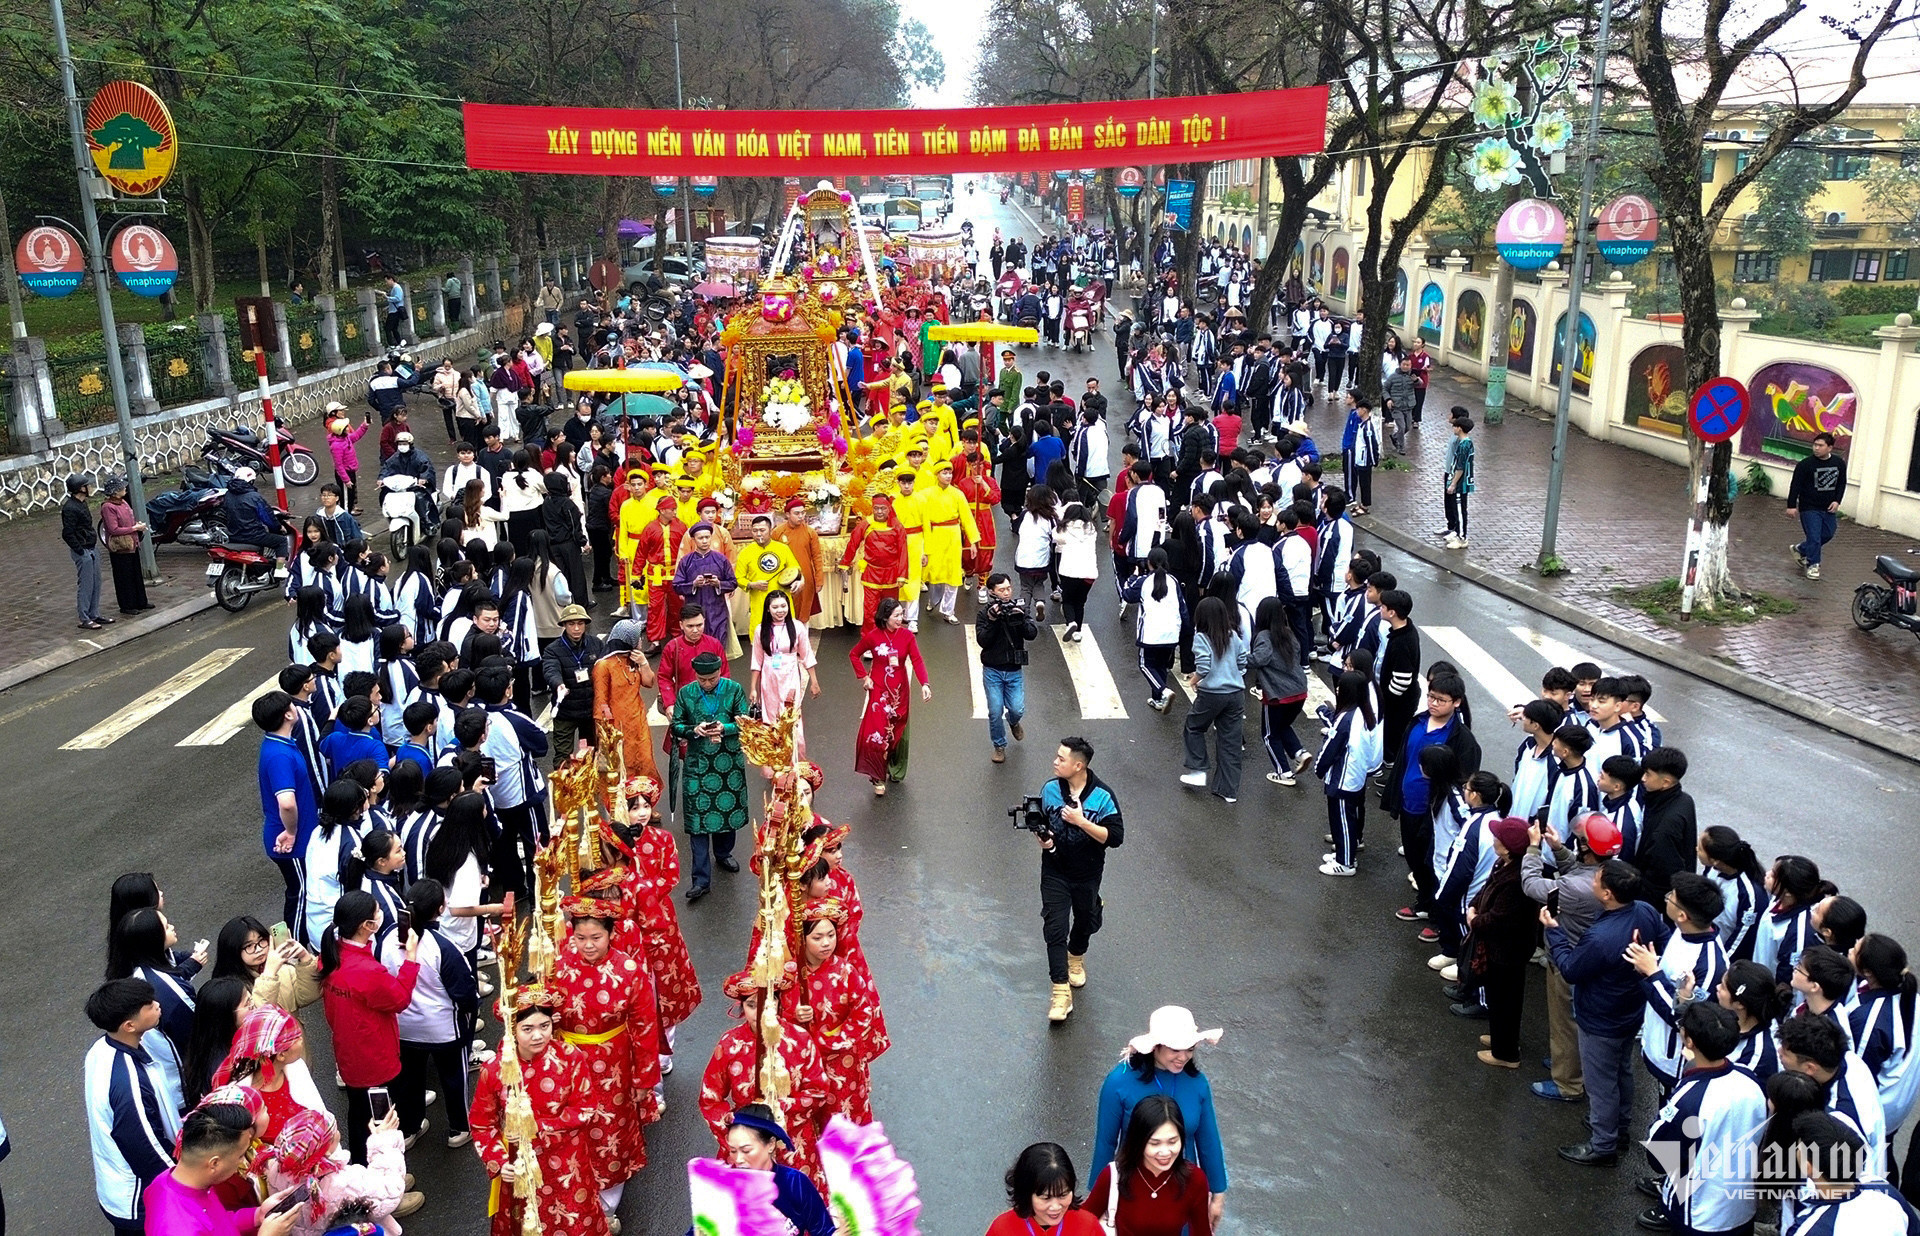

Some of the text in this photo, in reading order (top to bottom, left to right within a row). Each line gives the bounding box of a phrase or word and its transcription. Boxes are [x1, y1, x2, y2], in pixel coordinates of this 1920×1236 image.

[547, 126, 579, 155] XÂY
[591, 128, 638, 159] DỰNG
[647, 125, 682, 156] NỀN
[692, 128, 726, 157] VĂN
[736, 128, 770, 157] HÓA
[777, 129, 812, 160] VIỆT
[823, 132, 867, 159] NAM,
[873, 127, 910, 156] TIÊN
[922, 123, 959, 155] TIẾN
[970, 124, 1007, 157] ĐẬM
[1018, 123, 1041, 152] ĐÀ
[1049, 117, 1083, 151] BẢN
[1094, 115, 1127, 149] SẮC
[1137, 115, 1171, 147] DÂN
[1181, 113, 1213, 148] TỘC
[1503, 247, 1554, 260] vinaphone
[1603, 245, 1649, 257] vinaphone
[28, 277, 77, 289] vinaphone
[124, 276, 172, 288] vinaphone
